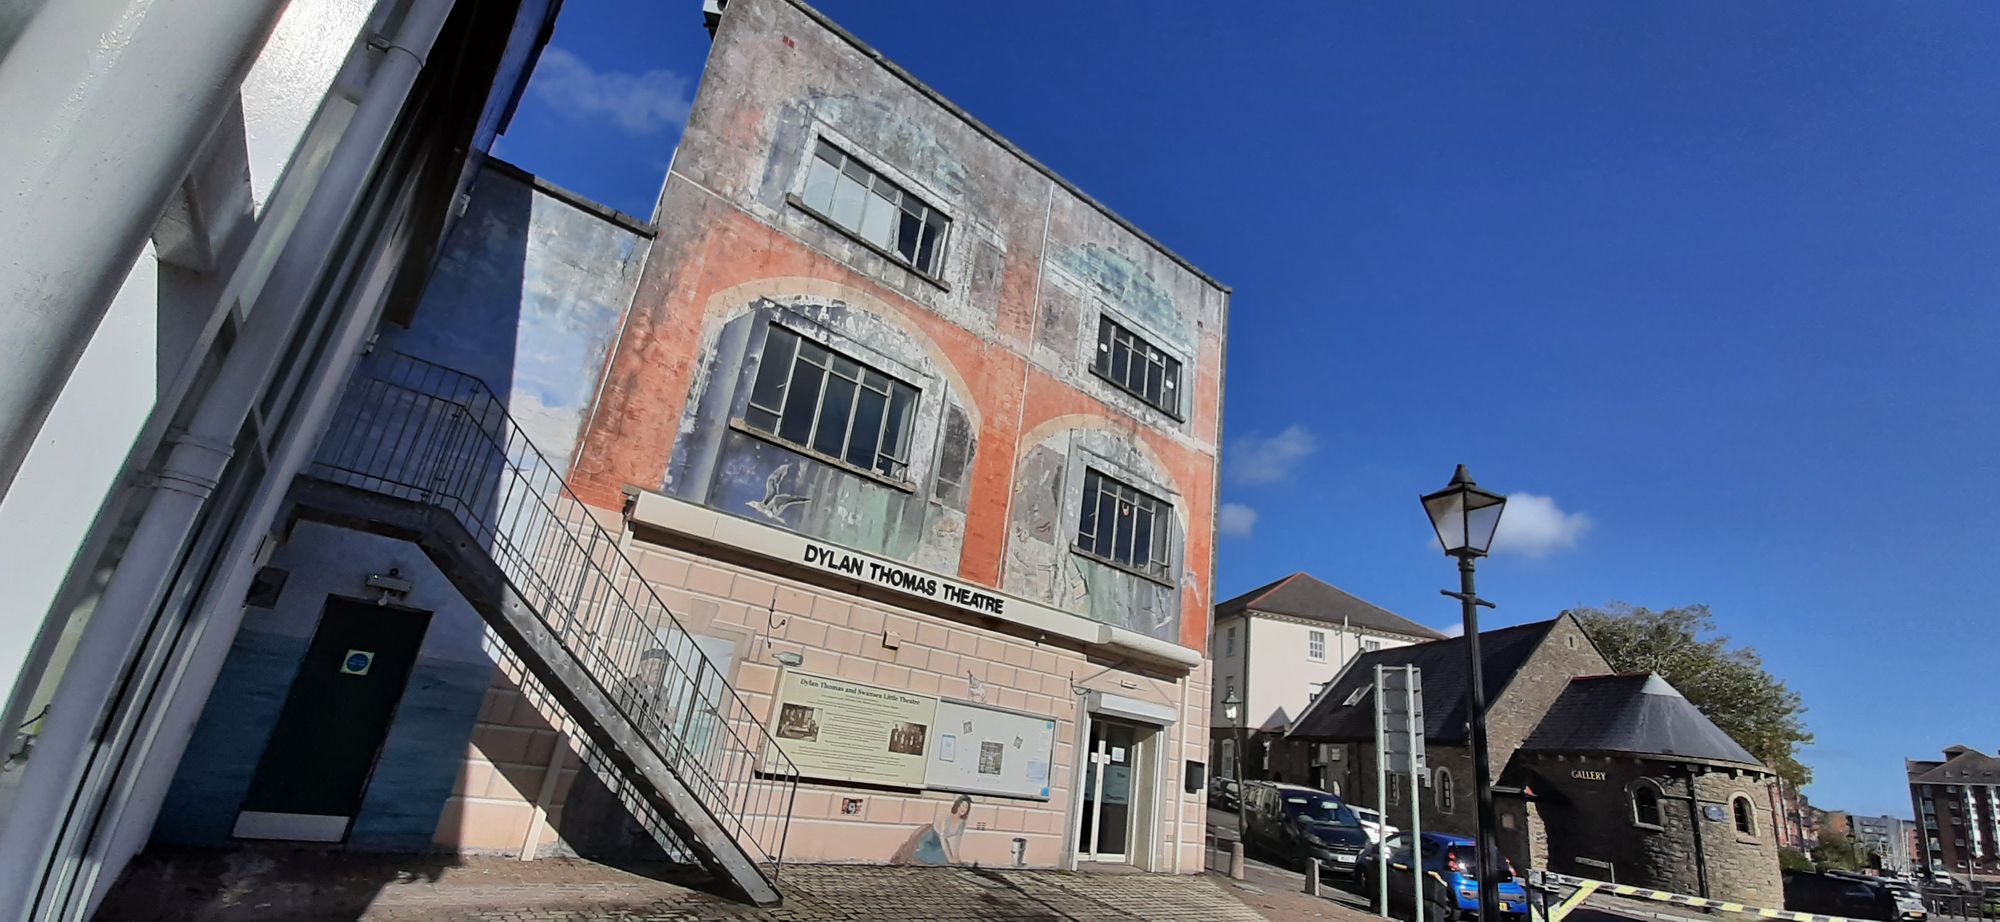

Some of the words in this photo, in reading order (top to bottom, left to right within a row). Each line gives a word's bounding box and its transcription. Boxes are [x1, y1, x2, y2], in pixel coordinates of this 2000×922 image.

[804, 544, 864, 577] DYLAN
[870, 562, 937, 596] THOMAS
[943, 583, 1004, 615] THEATRE
[800, 678, 819, 687] Dylan
[820, 681, 844, 692] Thomas
[857, 689, 882, 699] Swansea
[883, 693, 899, 701] Little
[900, 696, 920, 705] Theatre
[1571, 770, 1606, 781] GALLERY
